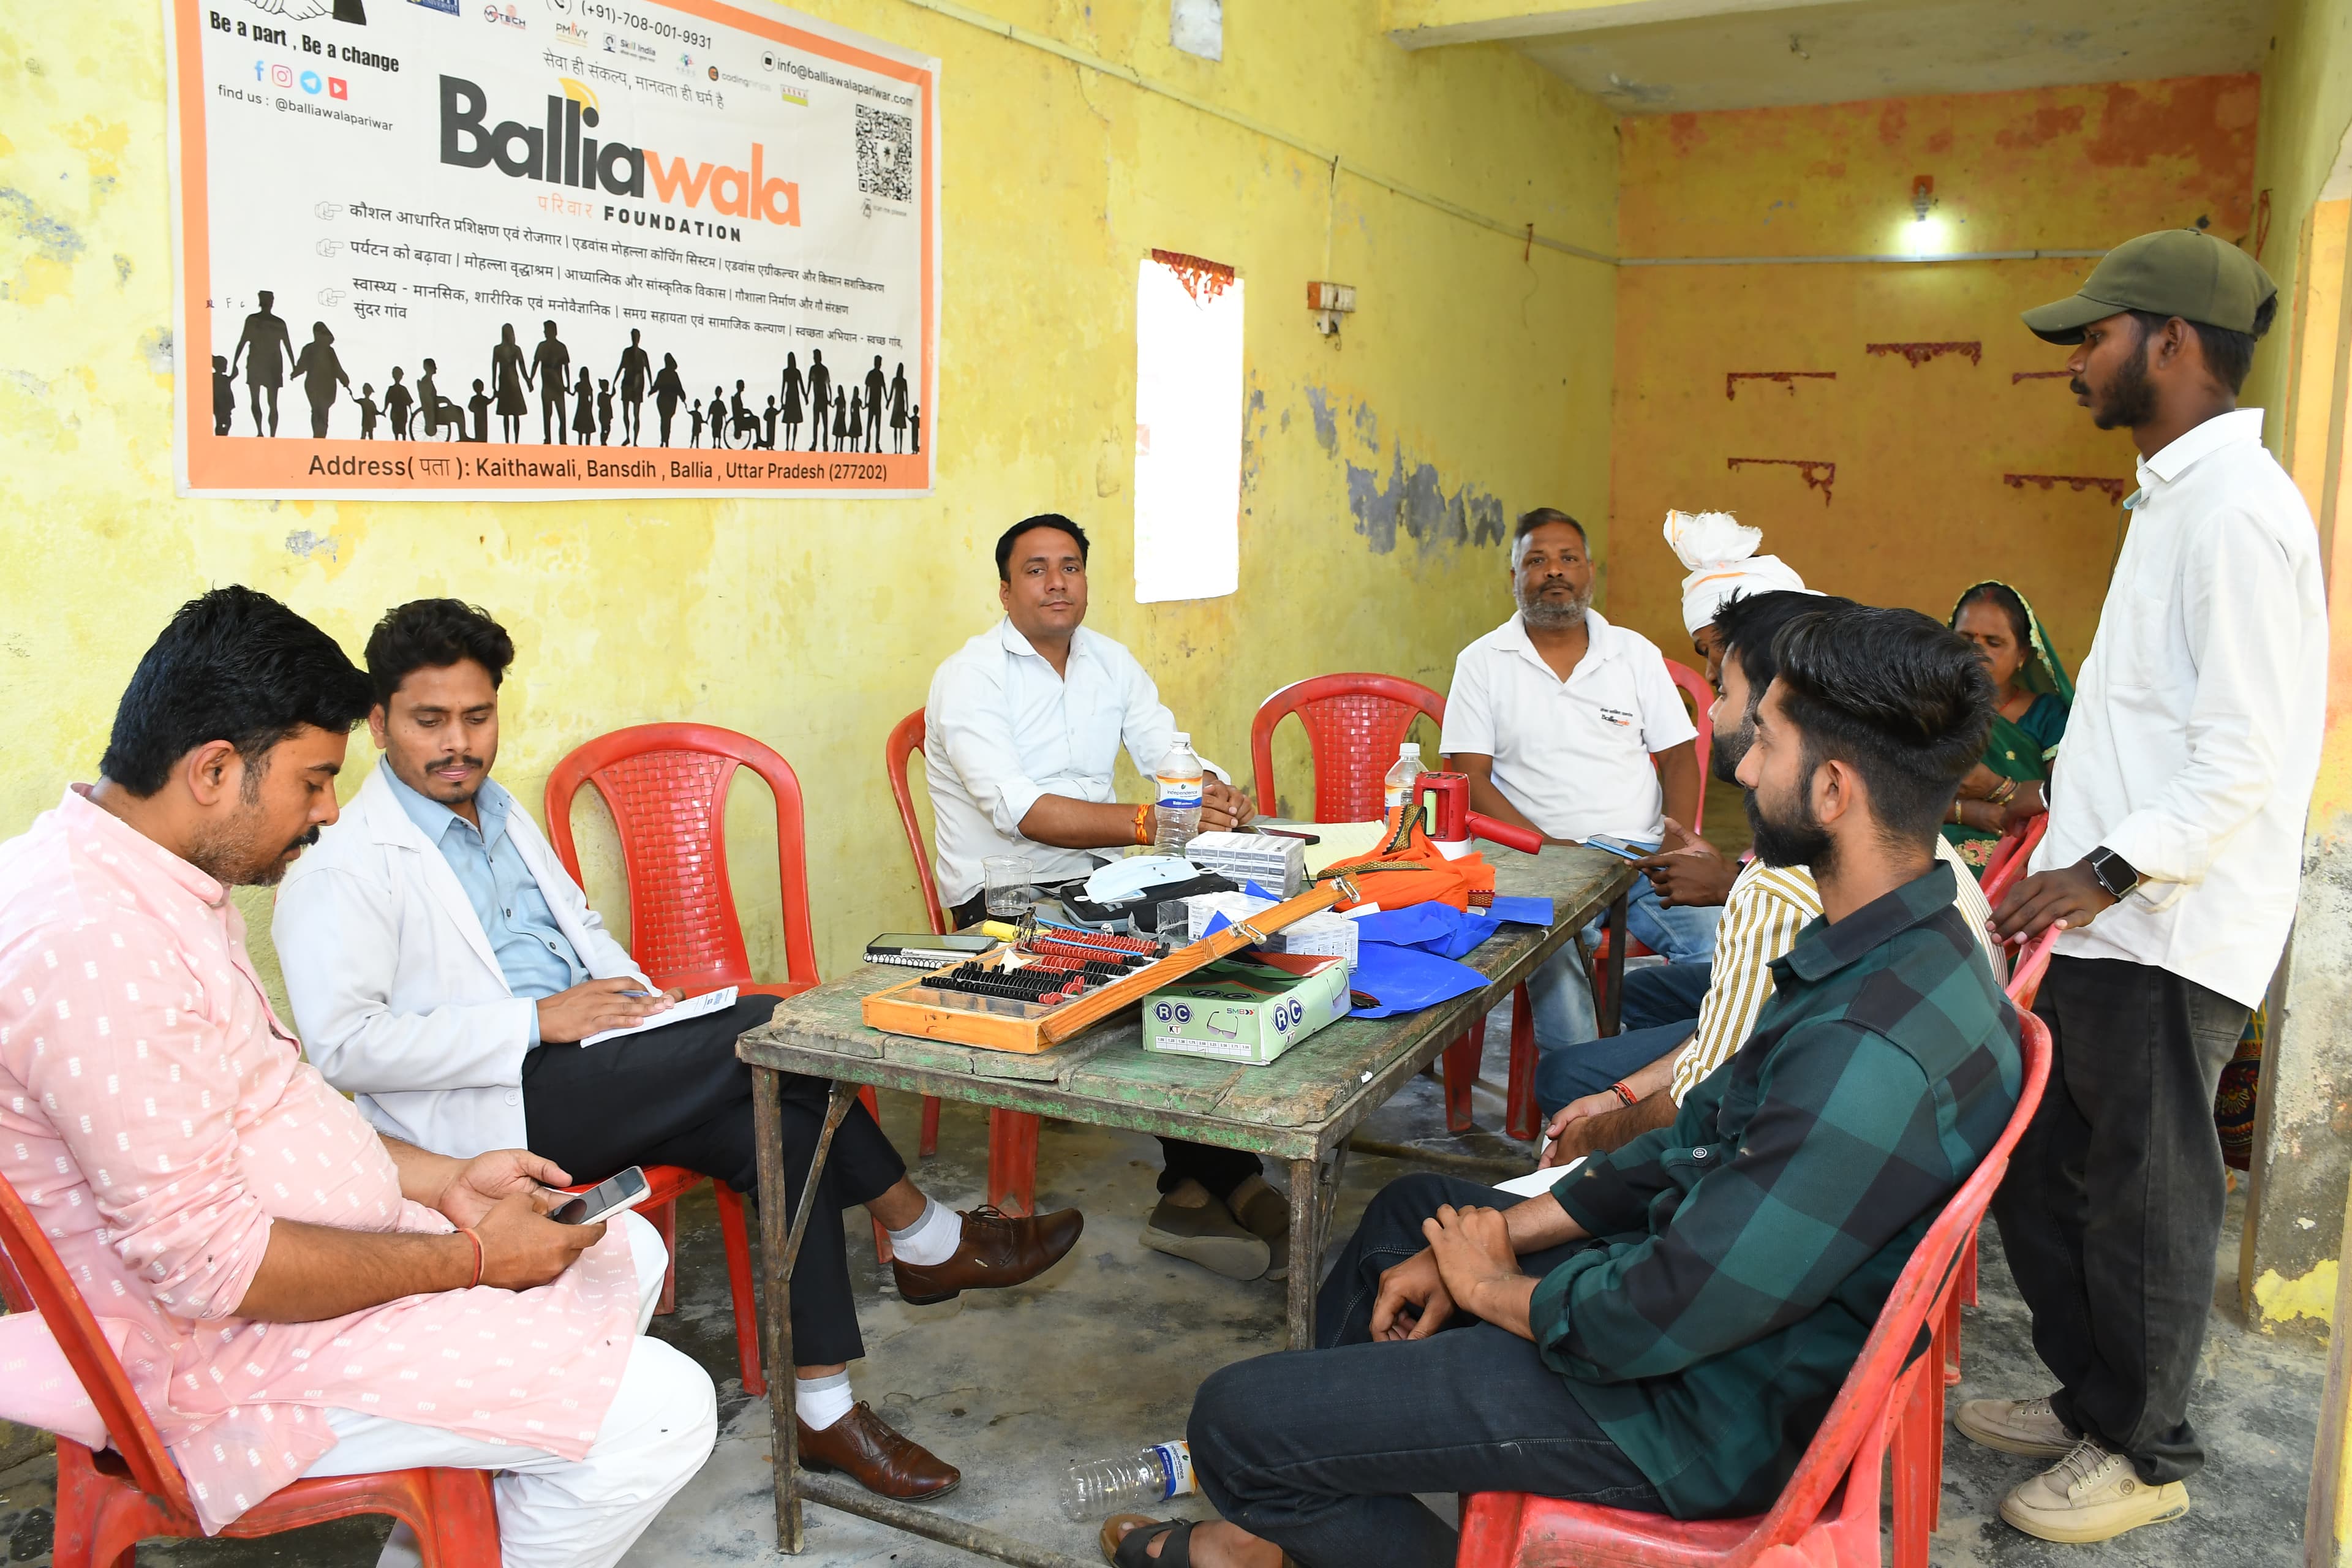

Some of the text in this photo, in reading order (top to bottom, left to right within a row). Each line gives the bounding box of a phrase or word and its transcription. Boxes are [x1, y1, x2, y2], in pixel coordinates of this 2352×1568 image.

[209, 10, 231, 32] Be
[237, 21, 247, 37] a
[252, 25, 287, 46] part
[302, 35, 322, 55] Be
[328, 43, 336, 58] a
[342, 47, 399, 72] change
[582, 1, 712, 50] (+91)-708-001-9931
[638, 42, 656, 56] India
[543, 48, 568, 71] सेवा
[571, 56, 584, 75] ही
[636, 76, 677, 98] मानवता
[680, 85, 692, 102] ही
[696, 90, 713, 107] धर्म
[715, 92, 725, 109] है
[777, 58, 913, 107] info@balliawalapariwar.com
[218, 85, 243, 100] find
[247, 93, 262, 105] us
[276, 98, 393, 131] @balliawalapariwar
[439, 74, 801, 227] Balliawala
[349, 202, 392, 221] कौशल
[397, 212, 450, 230] आधारित
[454, 217, 499, 237] प्रशिक्षण
[503, 226, 520, 241] एवं
[523, 227, 562, 246] रोजगार
[572, 238, 608, 253] एडवांस
[611, 241, 647, 258] मोहल्ला
[650, 247, 683, 263] कोचिंग
[686, 251, 716, 268] सिस्टम
[725, 260, 755, 273] एडवांस
[758, 263, 799, 280] एग्रीकल्चर
[802, 270, 816, 282] और
[818, 271, 842, 287] किसान
[605, 206, 741, 243] FOUNDATION
[350, 239, 390, 257] पर्यटन
[393, 243, 410, 260] को
[414, 249, 452, 266] बढ़ावा
[464, 252, 507, 271] मोहल्ला
[510, 262, 554, 278] वृद्धाश्रम
[564, 269, 621, 285] आध्यात्मिक
[624, 274, 643, 288] और
[646, 277, 692, 296] सांस्कृतिक
[695, 282, 726, 299] विकास
[735, 288, 766, 304] गौशाला
[769, 292, 796, 307] निर्माण
[799, 296, 813, 309] और
[825, 301, 849, 315] संरक्षण
[353, 300, 407, 319] सुंदर गांव
[353, 278, 397, 294] स्वास्थ्य
[413, 283, 469, 304] मानसिक,
[475, 289, 523, 306] शारीरिक
[527, 295, 543, 311] एवं
[548, 297, 611, 316] मनोवैज्ञानिक
[623, 307, 647, 320] समग्र
[650, 311, 687, 324] सहायता
[691, 314, 704, 328] एवं
[708, 316, 751, 331] सामाजिक
[754, 322, 786, 335] कल्याण
[796, 327, 824, 339] स्वच्छता
[827, 328, 858, 342] अभियान
[867, 335, 886, 345] स्वच्छ
[419, 458, 450, 476] पता
[477, 458, 582, 481] Kaithawali,
[587, 459, 656, 478] Bansdih
[671, 461, 713, 478] Ballia
[726, 462, 763, 479] Uttar
[768, 463, 824, 480] Pradesh
[829, 464, 888, 483] (277202)
